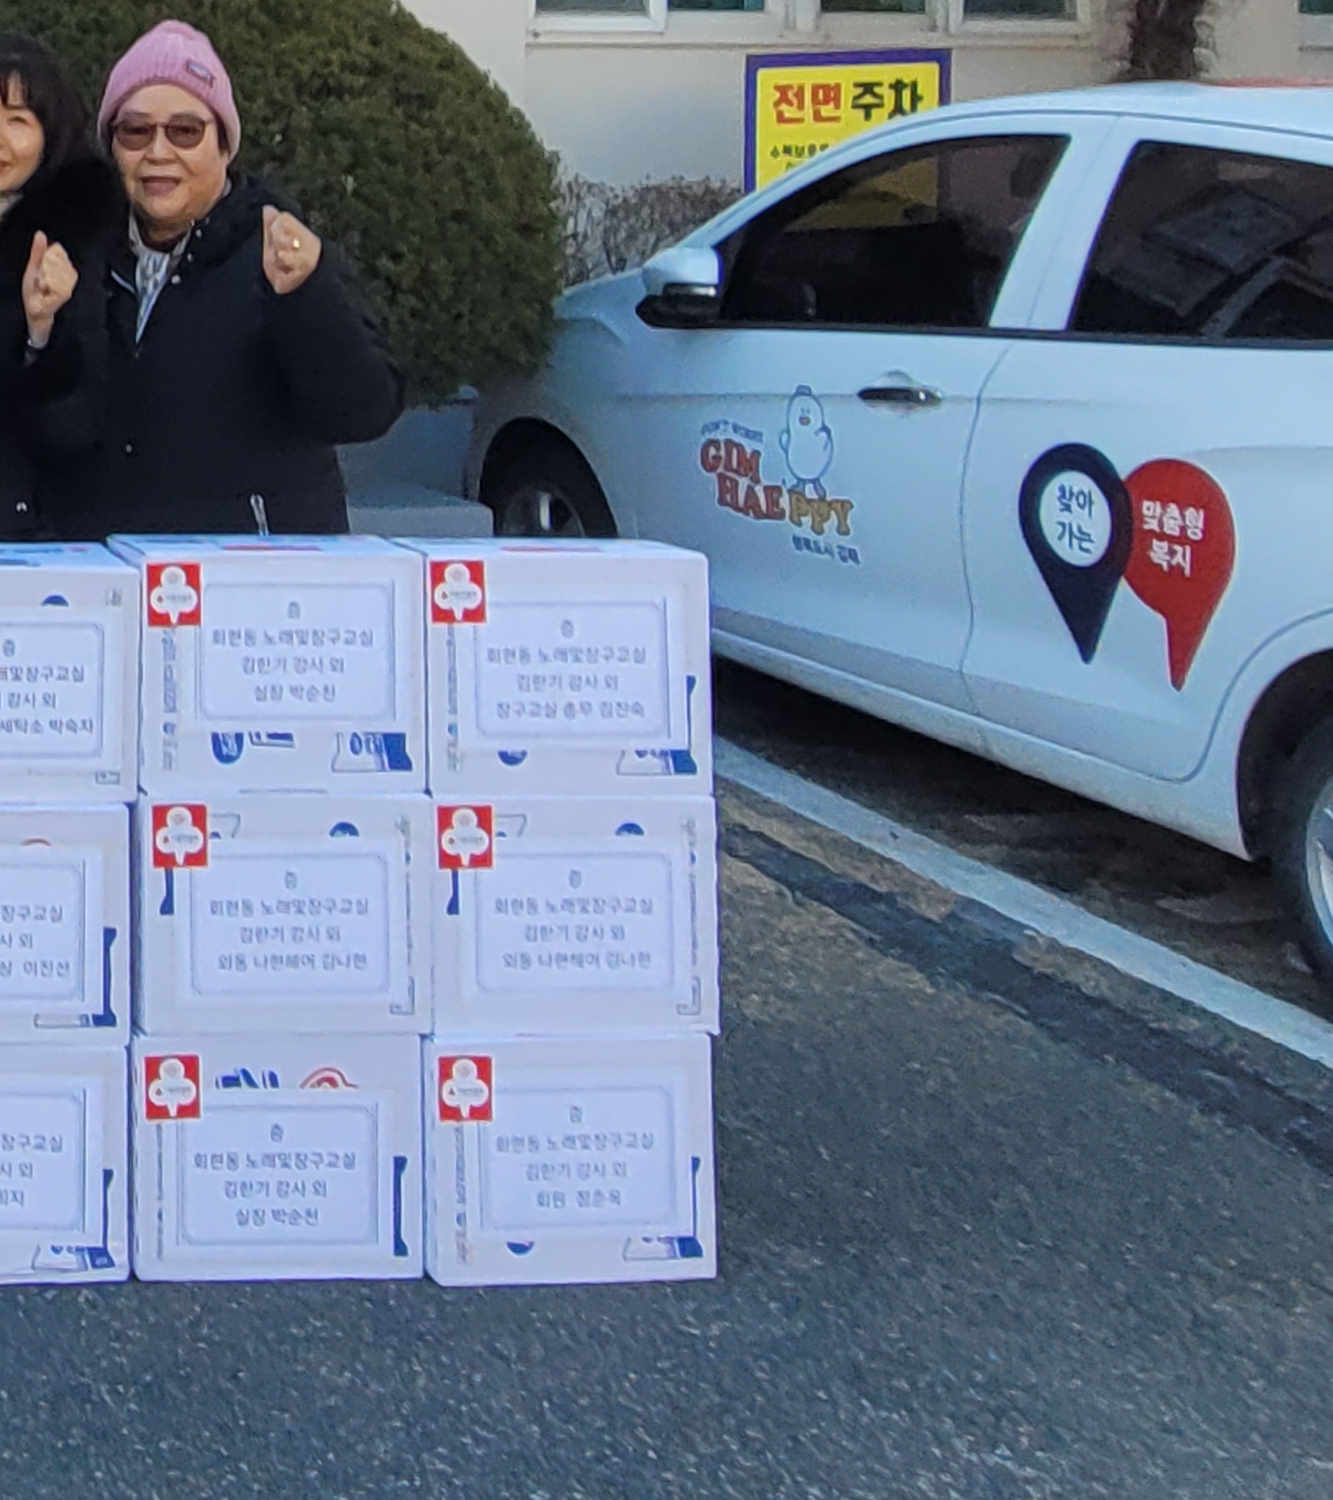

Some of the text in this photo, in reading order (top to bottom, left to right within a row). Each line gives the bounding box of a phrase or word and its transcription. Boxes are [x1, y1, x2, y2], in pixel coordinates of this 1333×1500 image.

[772, 77, 925, 125] 전면 주차
[700, 438, 761, 485] GIM
[717, 472, 855, 536] HAE PPY
[1057, 482, 1094, 519] 찾아
[1141, 499, 1205, 541] 맞춤형
[1055, 521, 1095, 555] 가는
[1148, 537, 1194, 578] 복지
[212, 628, 256, 647] 회현동
[242, 656, 344, 675] 김한기 강사 외
[8, 692, 36, 709] 강사
[42, 692, 56, 709] 외
[19, 933, 33, 949] 외
[18, 1162, 33, 1179] 외
[194, 1152, 239, 1171] 회현동
[224, 1180, 327, 1199] 김한기 강사 외
